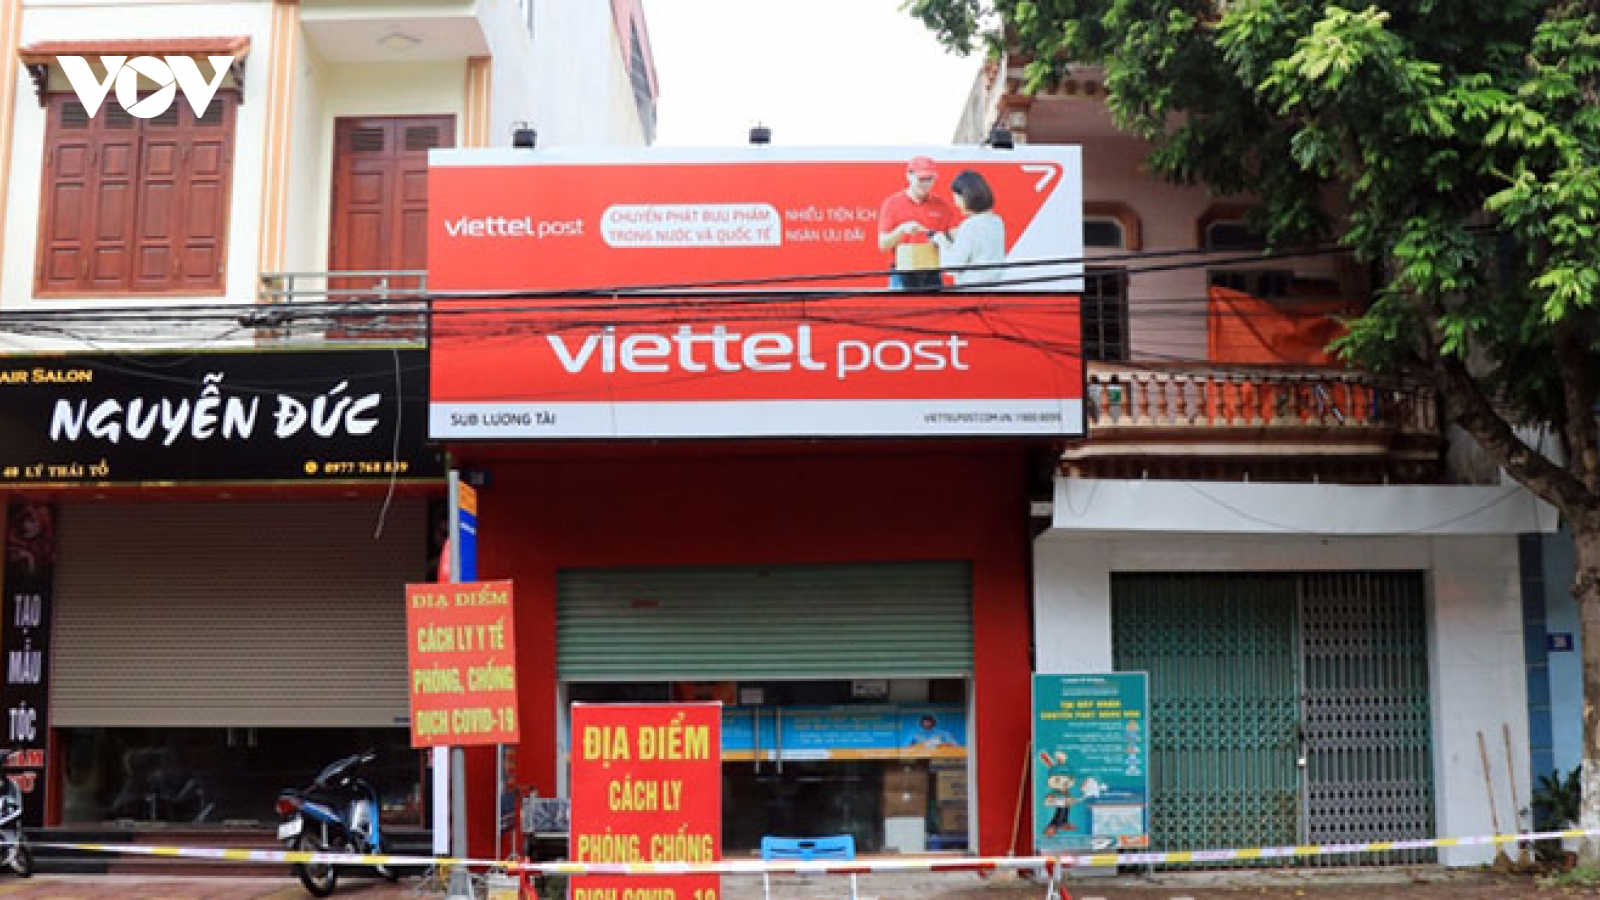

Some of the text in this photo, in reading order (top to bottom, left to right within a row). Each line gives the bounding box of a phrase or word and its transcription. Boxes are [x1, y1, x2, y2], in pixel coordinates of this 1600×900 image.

[444, 216, 584, 239] viettel post
[547, 325, 970, 379] viettel post
[50, 372, 382, 447] NGUYỄN ĐỨC
[450, 412, 479, 426] SUB
[417, 615, 505, 652] CÁCH LY Y TẾ
[9, 700, 37, 741] TÓC
[583, 724, 630, 768] ĐỊA
[638, 711, 710, 760] ĐIỂM
[609, 773, 683, 812] CÁCH LY
